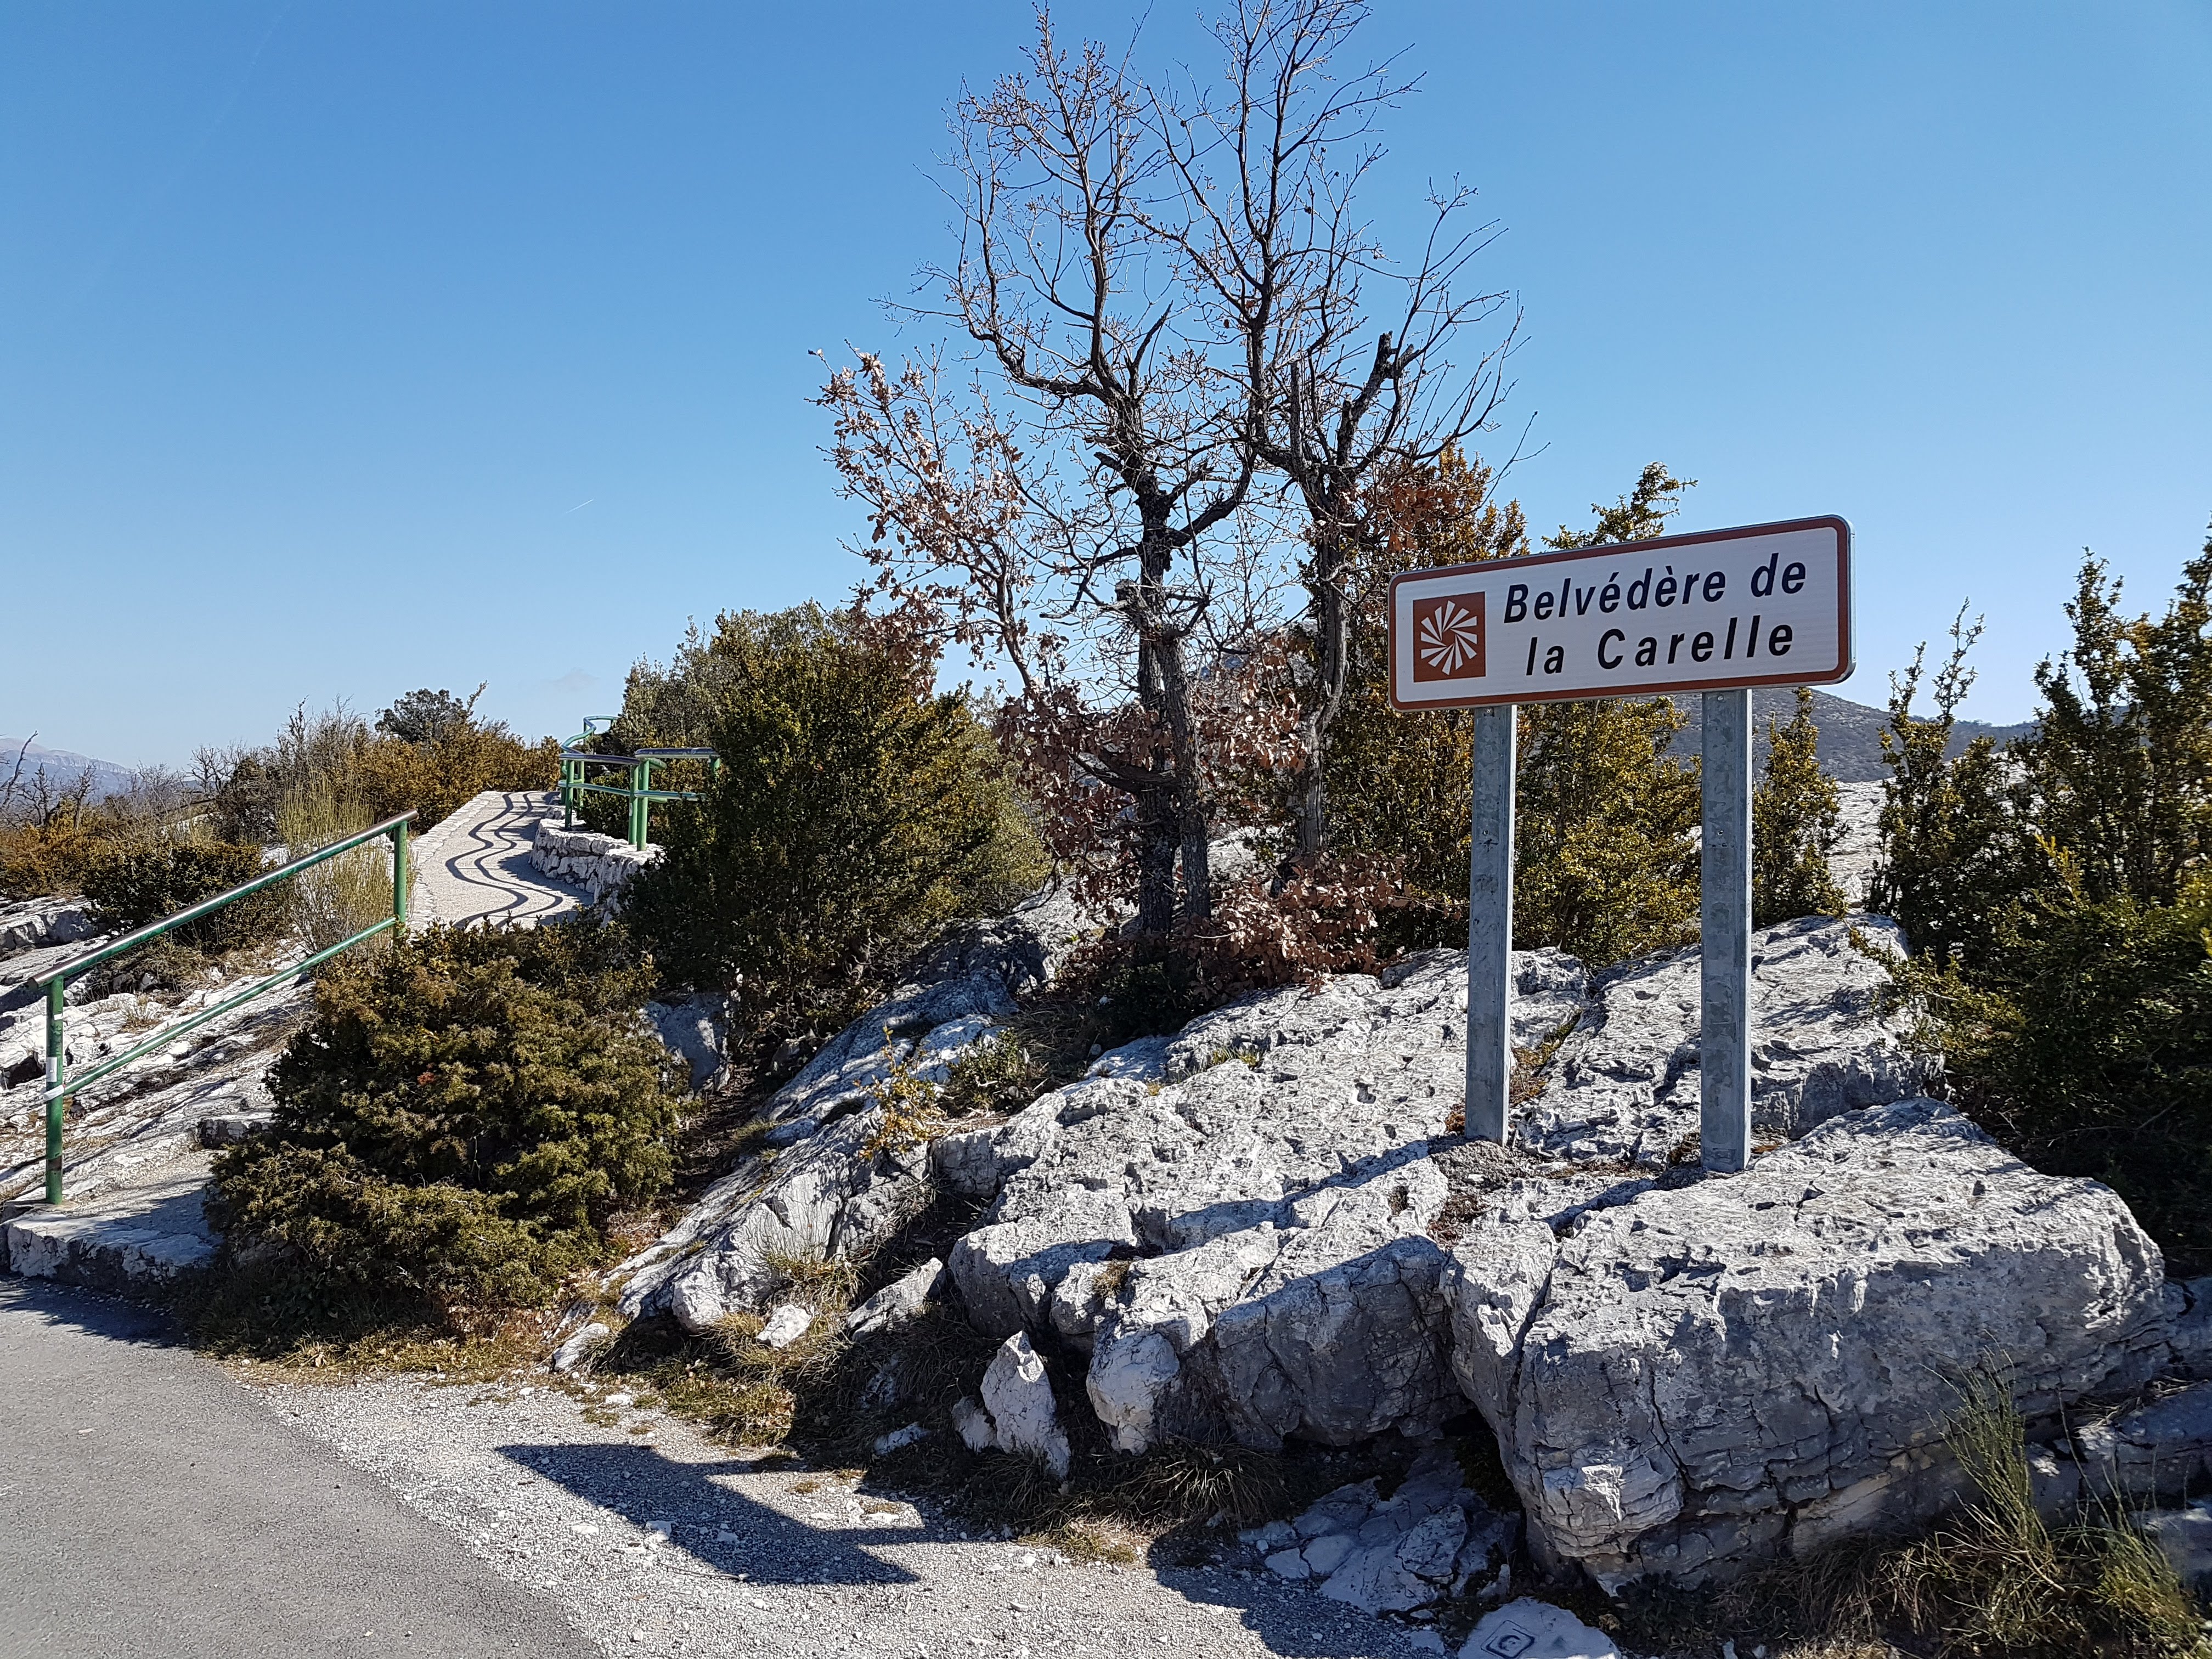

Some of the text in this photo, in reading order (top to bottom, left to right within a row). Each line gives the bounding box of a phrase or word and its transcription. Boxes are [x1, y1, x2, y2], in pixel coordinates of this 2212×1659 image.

[1503, 552, 1807, 624] Belvédère de
[1526, 614, 1793, 676] la Carelle
